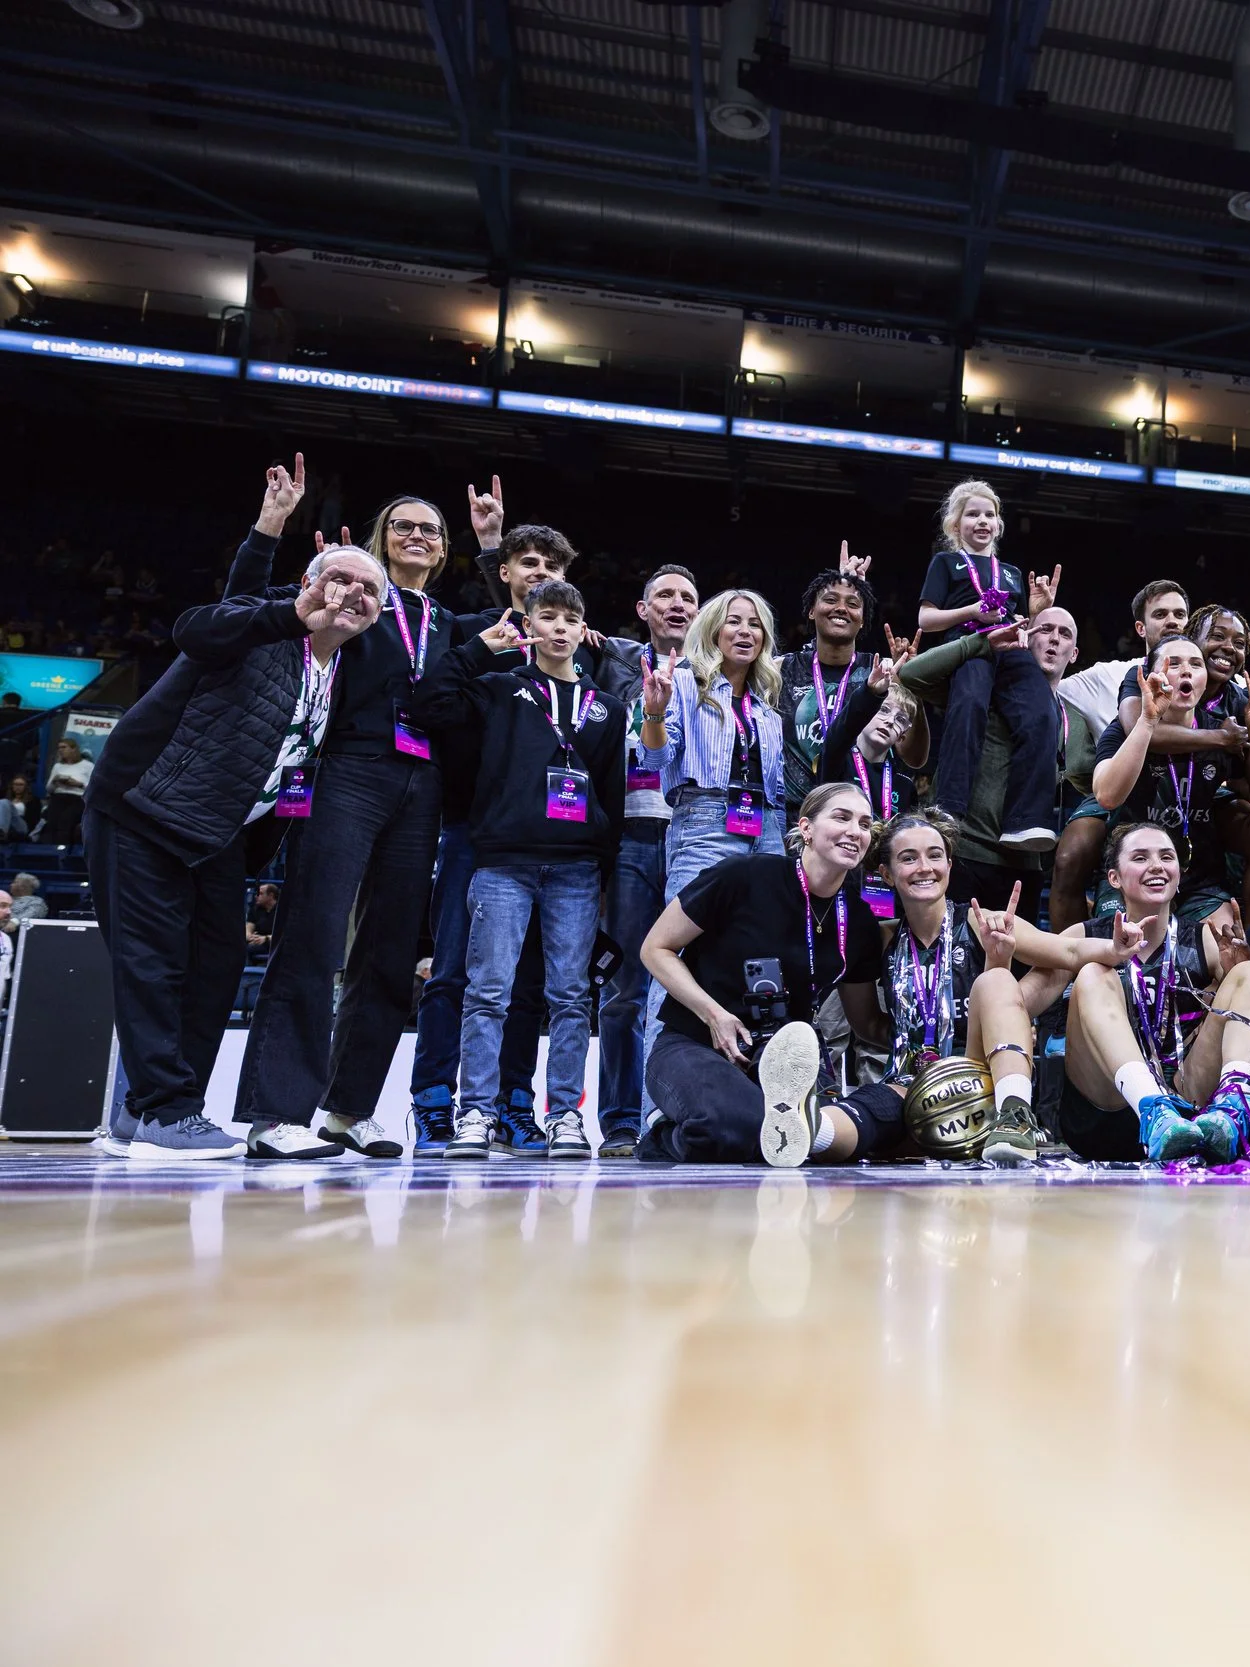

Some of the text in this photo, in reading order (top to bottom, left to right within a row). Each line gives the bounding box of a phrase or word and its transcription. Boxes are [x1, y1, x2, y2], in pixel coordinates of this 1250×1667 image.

[312, 251, 402, 272] WeatherTech
[783, 315, 912, 341] FIRE & SECURITY
[33, 340, 184, 367] at unbeatable prices
[278, 367, 403, 394] MOTORPOINT
[570, 401, 616, 420] buying
[998, 452, 1102, 476] Buy your car today
[390, 589, 417, 669] LEAGUE BASKETBALL CUP
[419, 627, 427, 649] LEAGUE
[578, 700, 591, 720] LEAGUE
[74, 718, 112, 729] SHARKS
[553, 724, 564, 737] CUP
[738, 732, 746, 746] CUP
[282, 795, 306, 803] TEAM
[559, 800, 576, 808] VIP
[921, 1077, 984, 1111] molten
[938, 1109, 986, 1137] MVP
